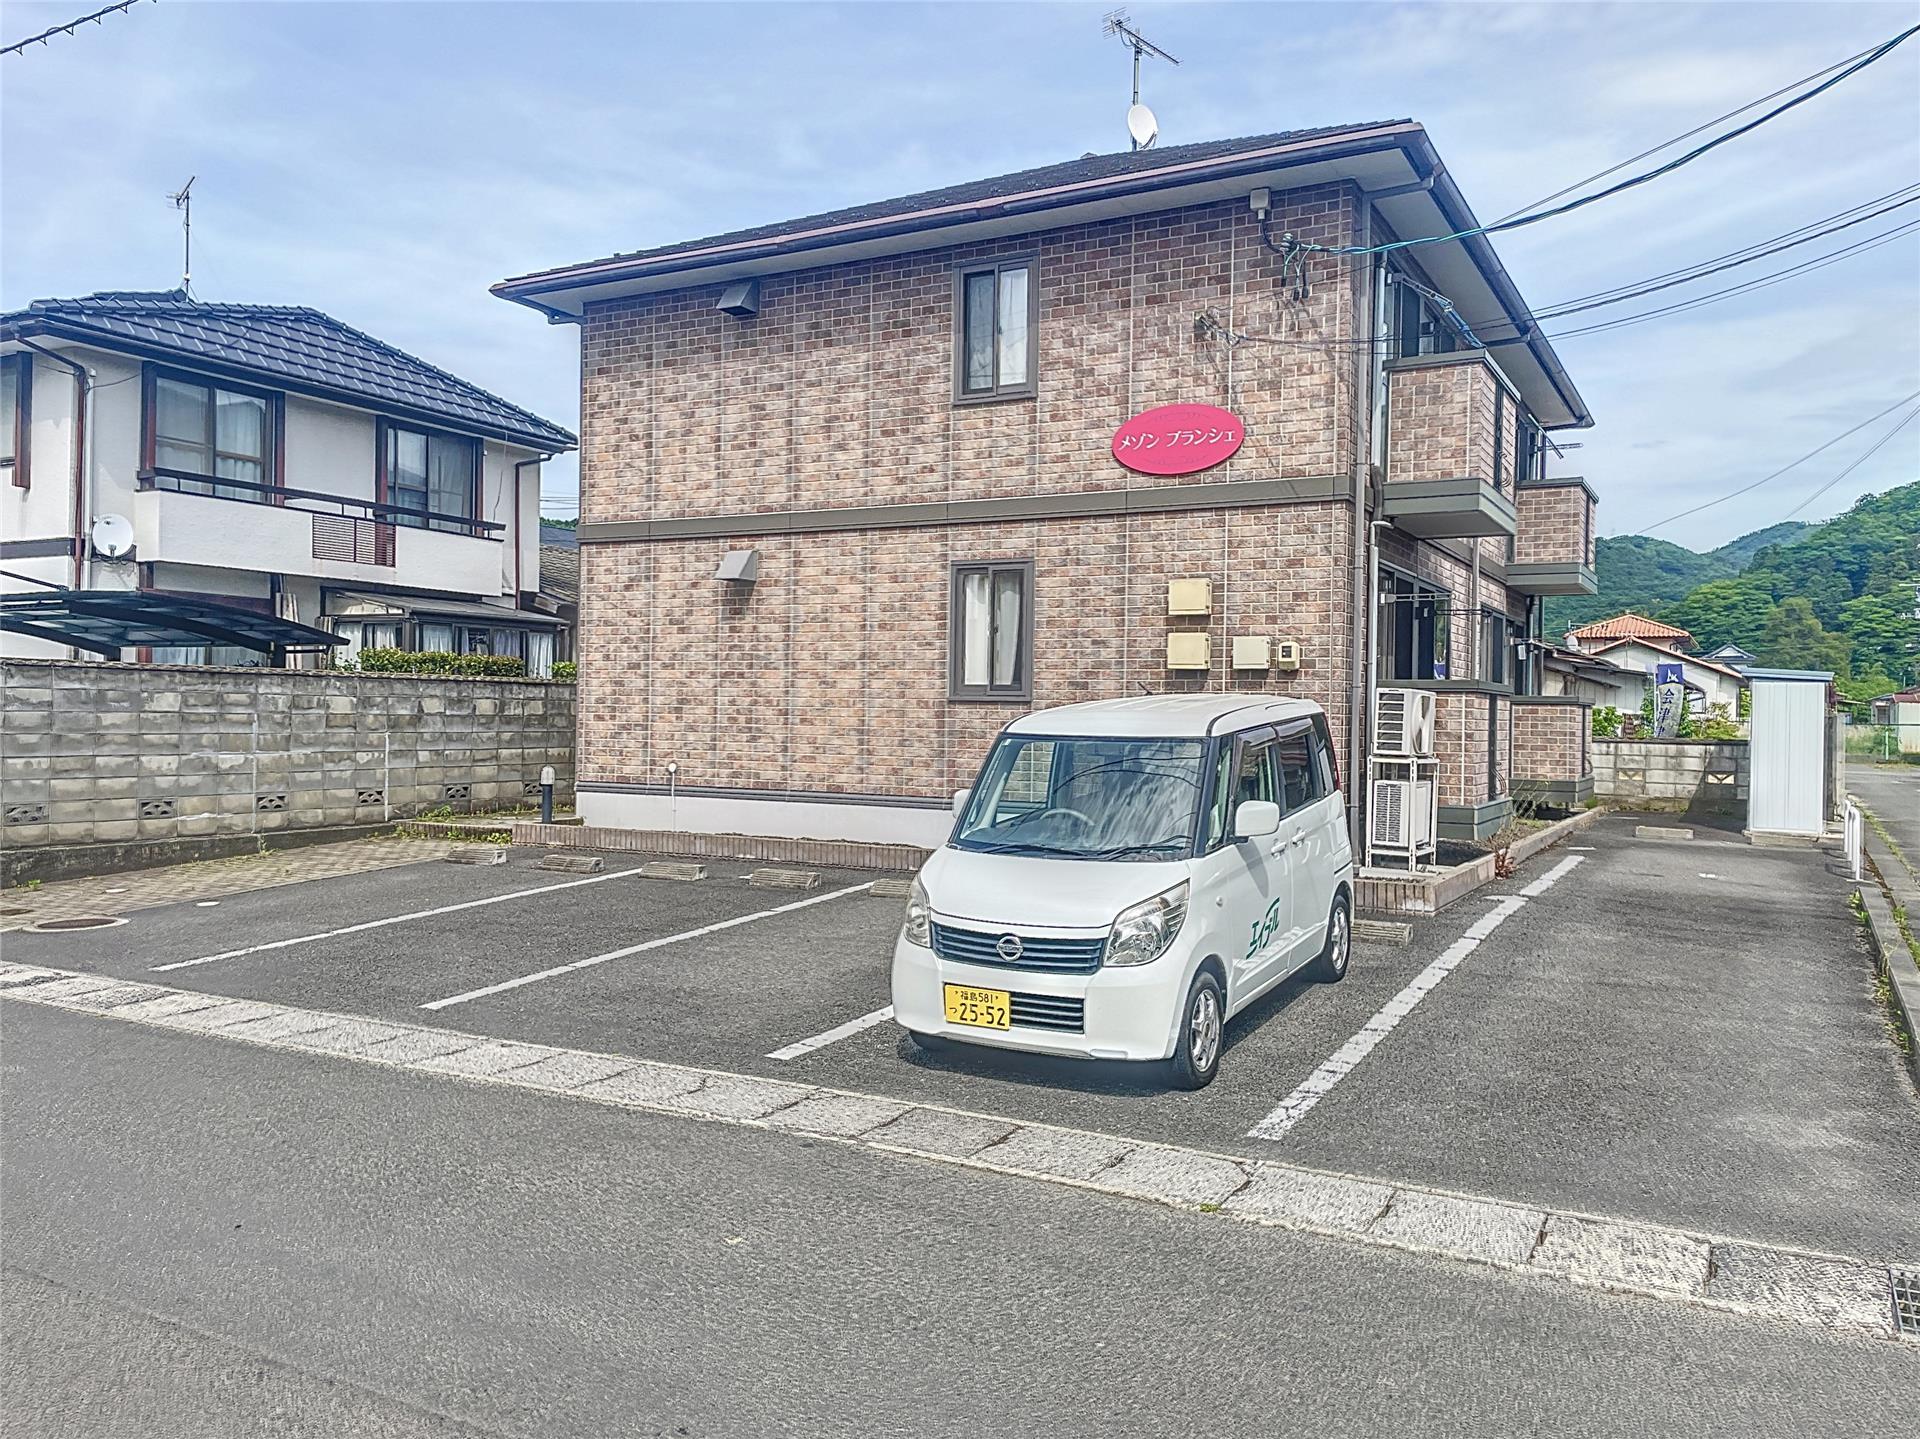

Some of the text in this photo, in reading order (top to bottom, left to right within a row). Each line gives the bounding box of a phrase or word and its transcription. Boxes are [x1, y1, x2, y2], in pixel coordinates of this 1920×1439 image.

[1118, 432, 1160, 451] メゾン
[959, 1002, 1006, 1027] 25-52
